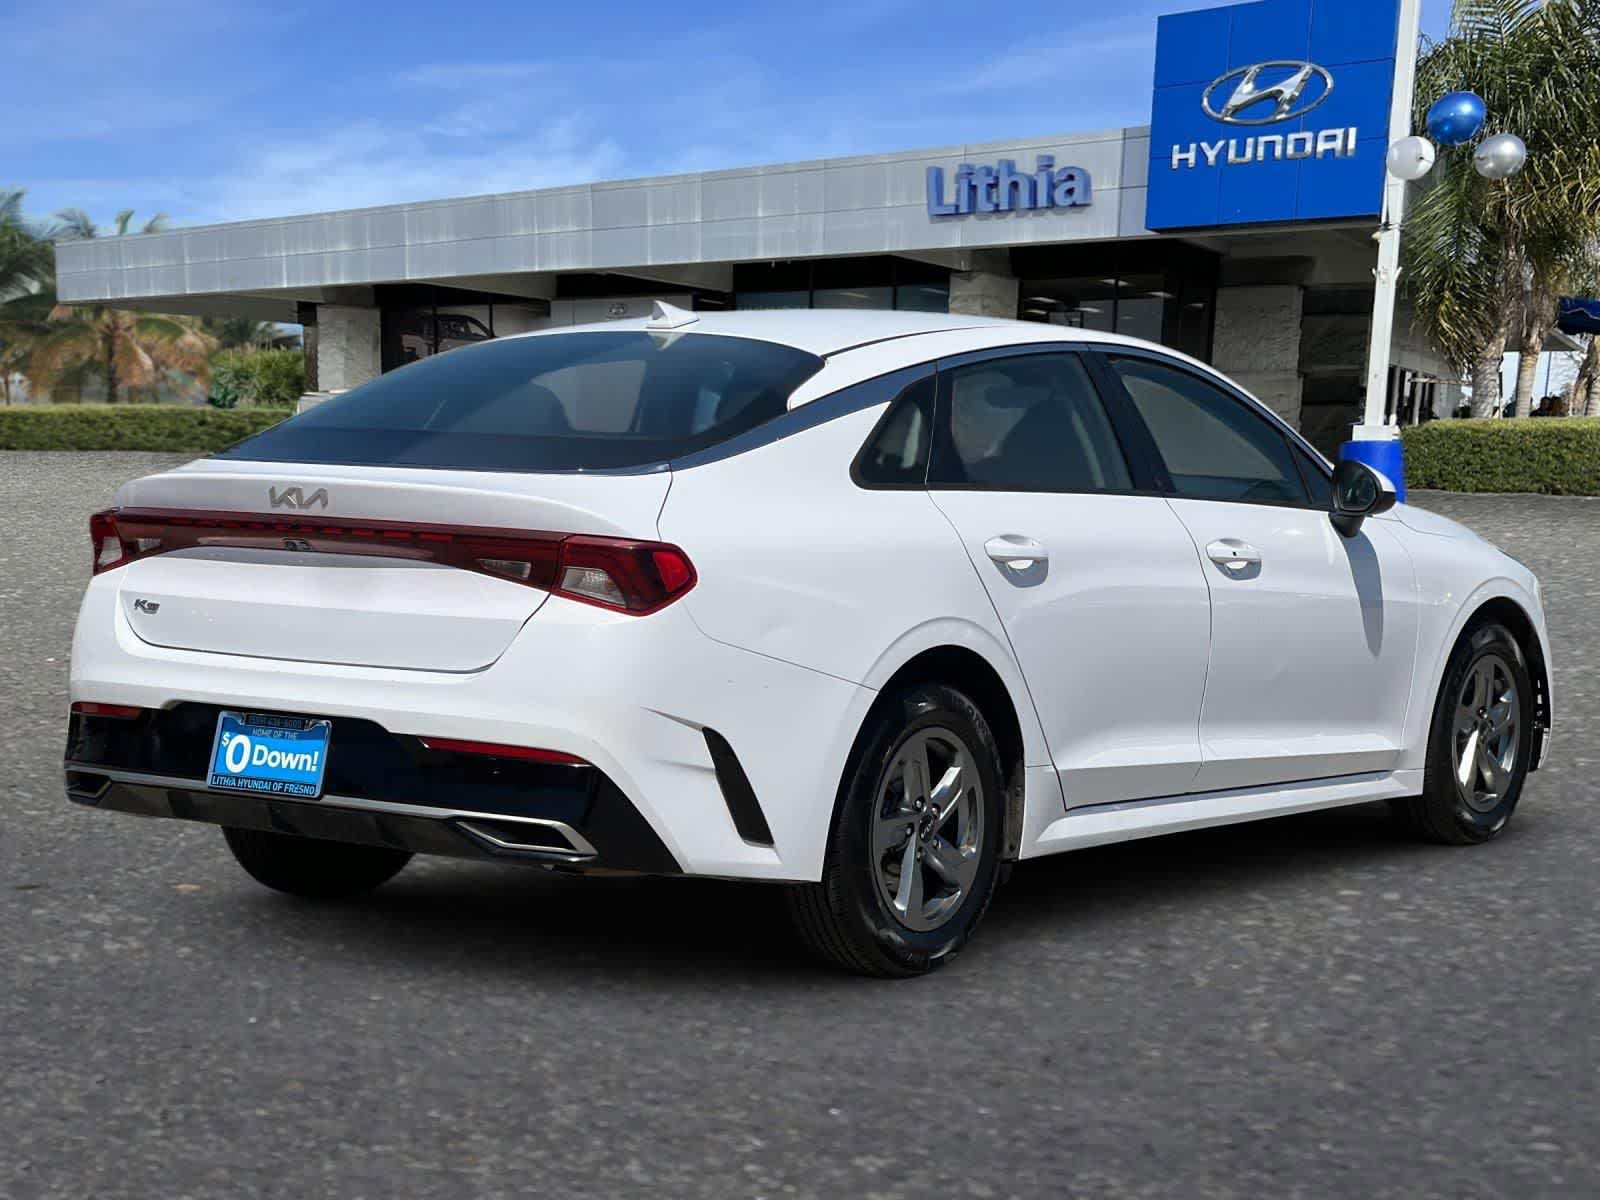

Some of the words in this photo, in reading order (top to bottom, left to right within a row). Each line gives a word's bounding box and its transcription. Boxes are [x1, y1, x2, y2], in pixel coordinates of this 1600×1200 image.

[1171, 126, 1357, 170] HYUNDAI
[925, 155, 1092, 217] Lithia
[252, 744, 319, 772] Down!
[212, 775, 236, 787] LITHIA
[237, 778, 272, 790] HYUNDAI
[272, 782, 282, 792] OF
[283, 784, 315, 795] FRESNO
